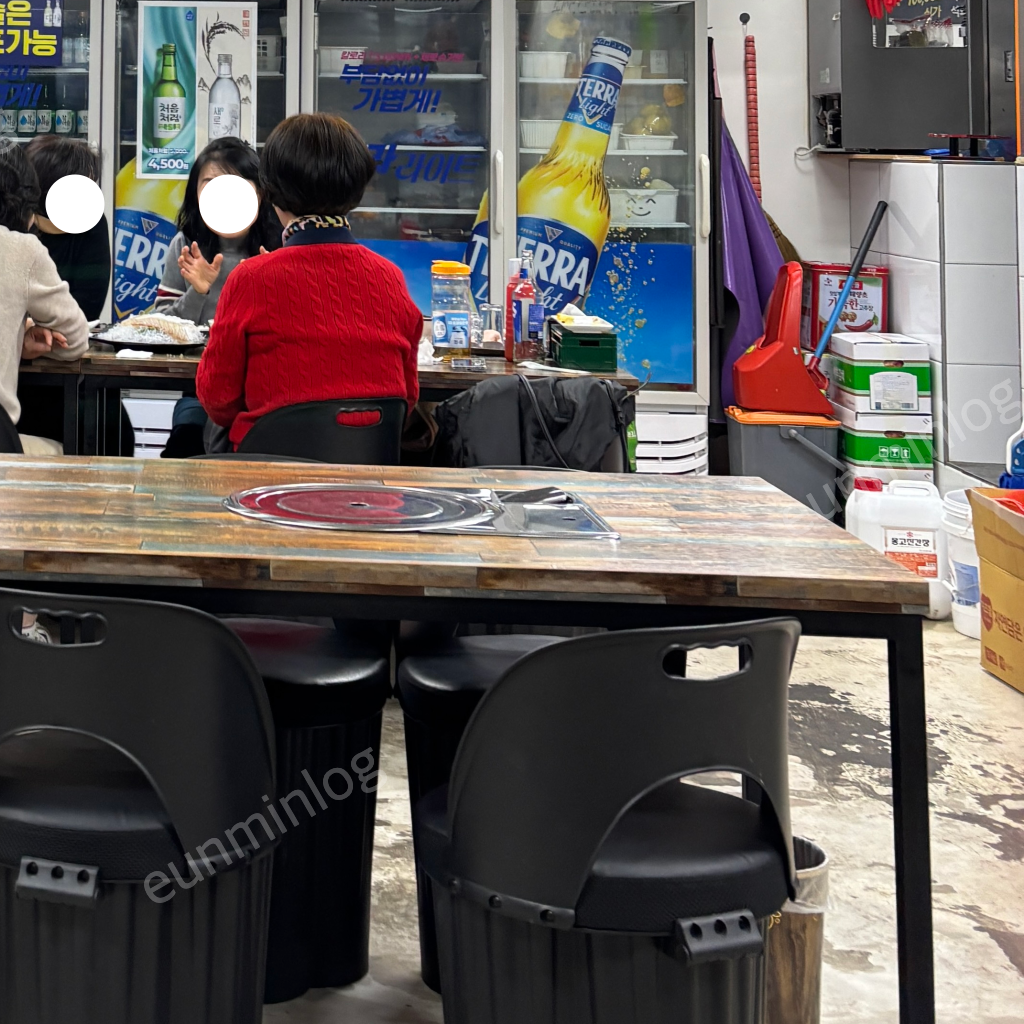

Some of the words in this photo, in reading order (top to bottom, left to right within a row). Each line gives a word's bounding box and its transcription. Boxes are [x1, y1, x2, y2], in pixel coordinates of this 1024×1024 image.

[339, 63, 430, 86] 부담없이
[576, 78, 620, 106] TERRA
[579, 97, 613, 116] Light
[559, 239, 582, 250] QUALITY
